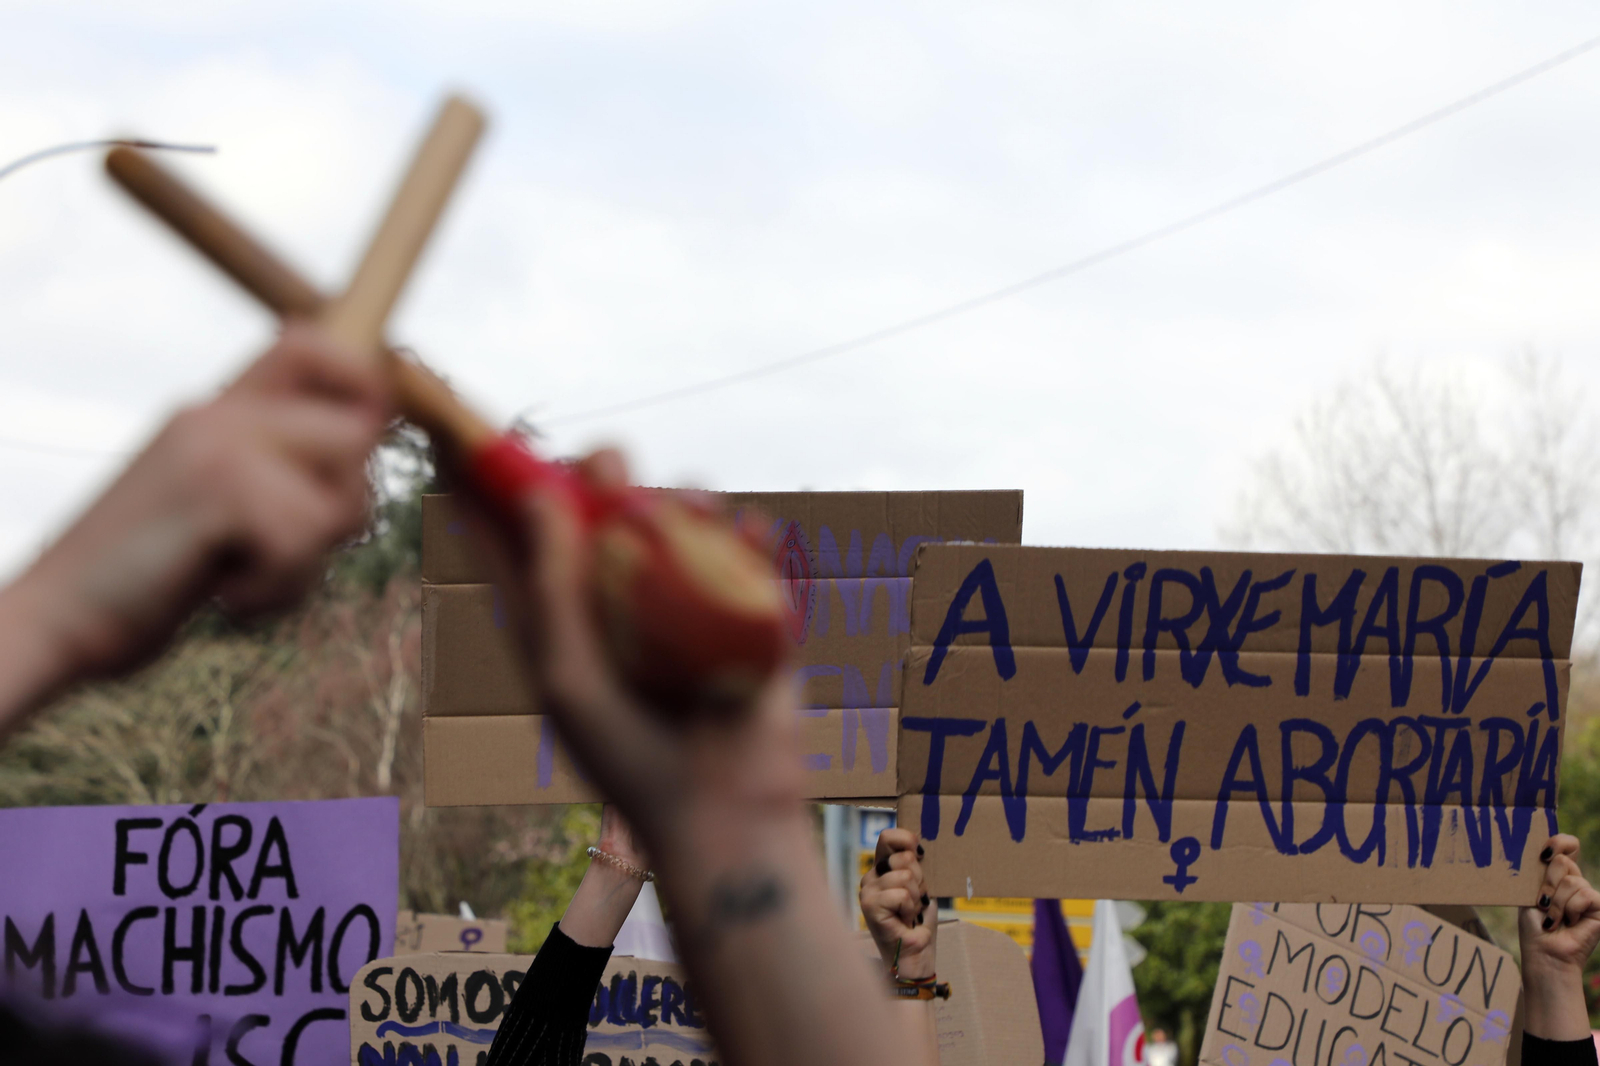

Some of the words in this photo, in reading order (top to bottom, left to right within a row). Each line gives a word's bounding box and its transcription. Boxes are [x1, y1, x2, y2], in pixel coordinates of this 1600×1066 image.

[924, 558, 1016, 685] A
[1294, 561, 1559, 721] MARÍA
[901, 703, 1187, 845] TAMÉN
[1211, 703, 1559, 876] ABORTARÍA
[113, 803, 299, 901] FÓRA
[5, 904, 381, 999] MACHISMO
[1266, 929, 1474, 1066] MODELO
[1272, 903, 1393, 961] OR
[1423, 924, 1504, 1010] UN
